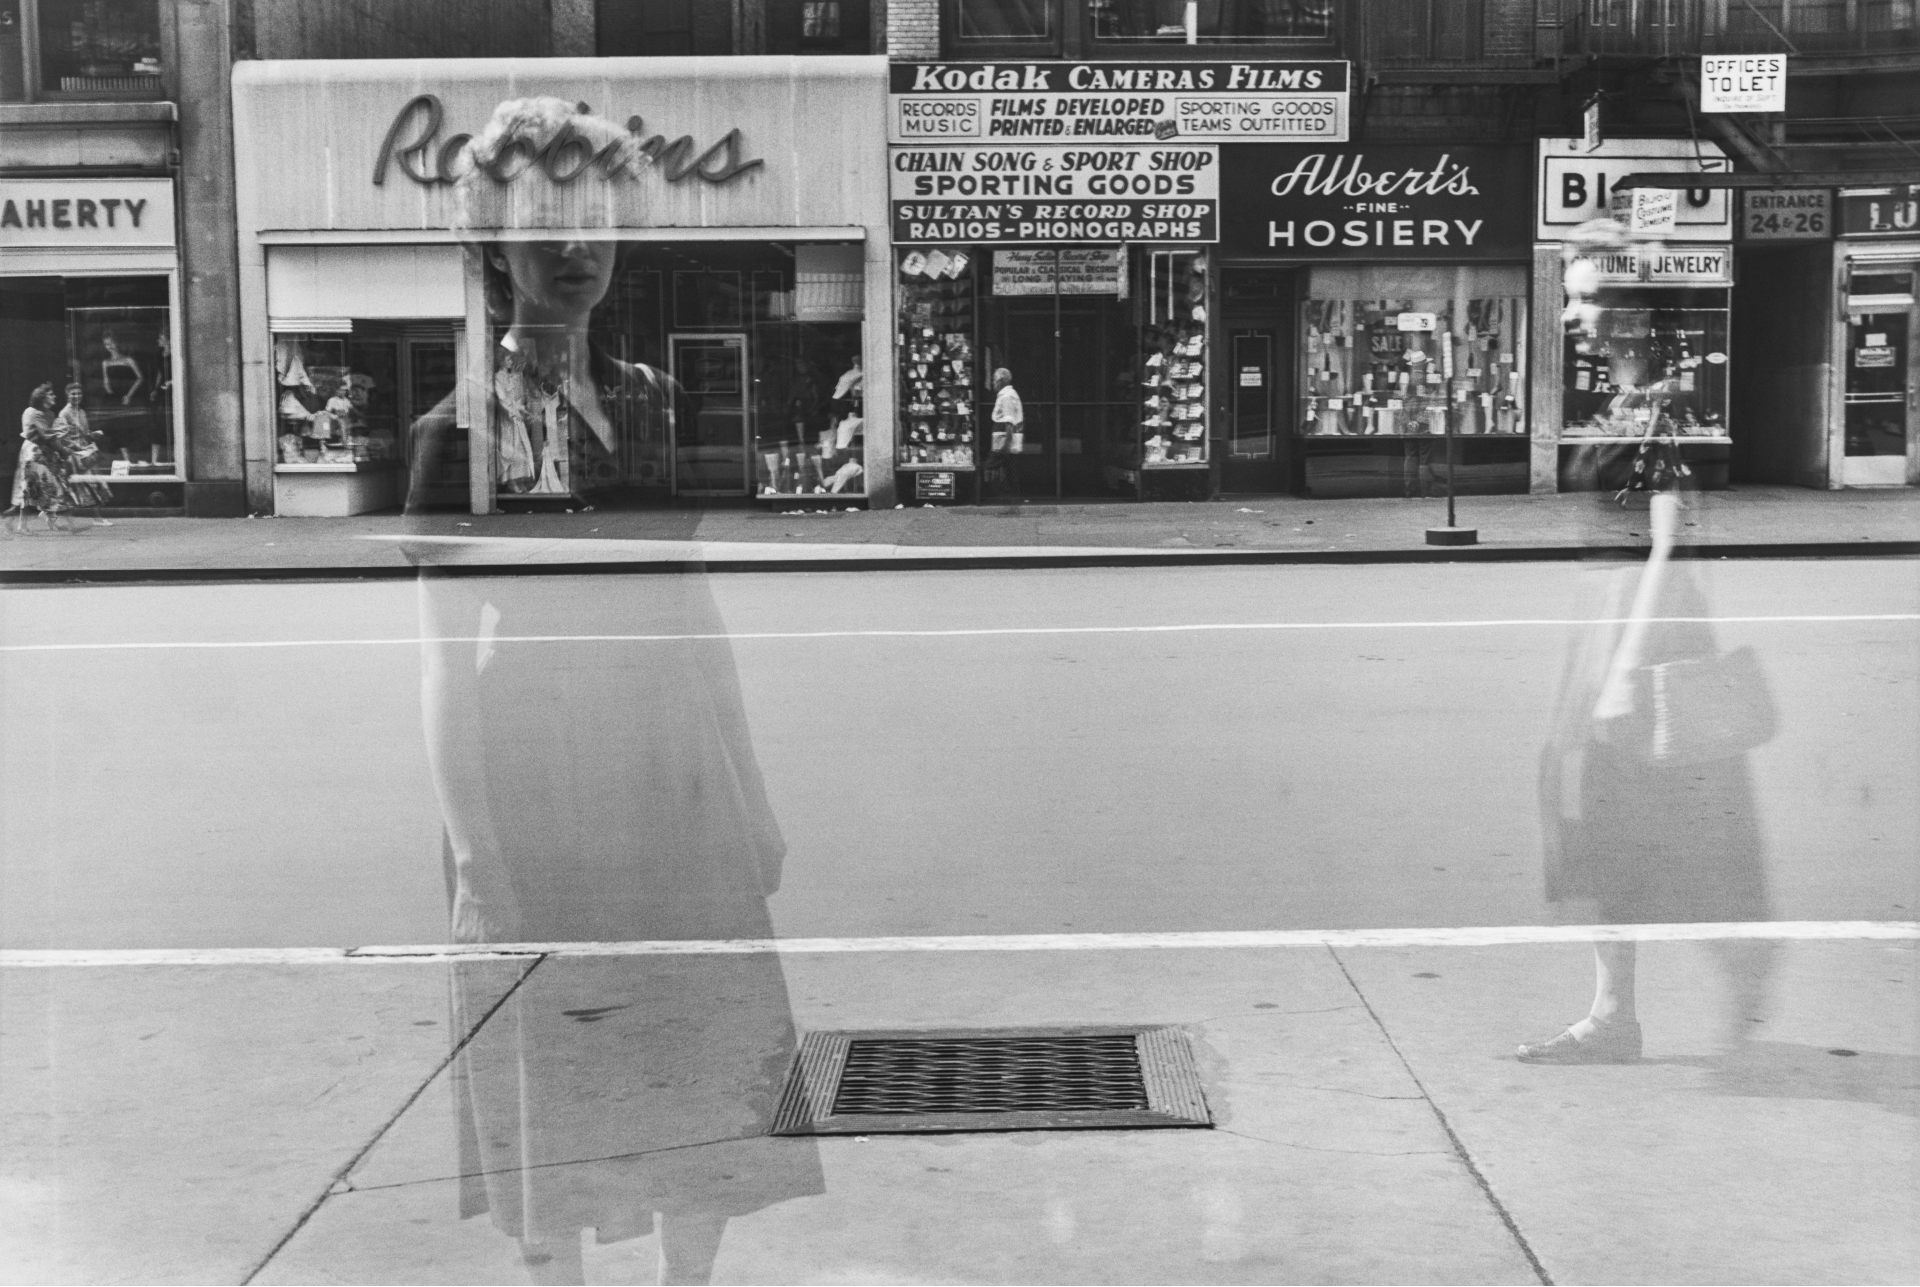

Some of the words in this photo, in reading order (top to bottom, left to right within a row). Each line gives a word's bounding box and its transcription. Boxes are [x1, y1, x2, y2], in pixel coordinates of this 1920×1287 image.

[1705, 60, 1779, 73] OFFICES
[912, 65, 1051, 91] Kodak
[1068, 65, 1215, 90] CAMERAS
[1226, 64, 1323, 90] FILMS
[1708, 76, 1732, 92] TO
[1740, 75, 1777, 92] LET
[902, 102, 977, 117] RECORDS
[990, 98, 1047, 116] FILMS
[1055, 98, 1165, 116] DEVELOPED
[1180, 101, 1261, 116] SPORTING
[1272, 101, 1334, 115] GOODS
[905, 119, 972, 133] MUSIC
[988, 118, 1064, 136] PRINTED
[1073, 118, 1155, 136] ENLARGED
[1183, 118, 1232, 132] TEAMS
[1239, 118, 1326, 132] OUTFITTED
[895, 152, 965, 172] CHAIN
[972, 152, 1037, 171] SONG
[1042, 157, 1054, 172] &
[1060, 151, 1141, 171] SPORT
[1149, 151, 1213, 171] SHOP
[1271, 153, 1480, 196] Albert's
[914, 174, 1073, 196] SPORTING
[1088, 174, 1195, 195] GOODS
[1562, 172, 1711, 209] BIU
[1356, 202, 1399, 213] FINE
[1751, 195, 1825, 208] ENTRANCE
[1, 199, 147, 229] AHERTY
[899, 204, 1024, 220] SULTAN'S
[1033, 204, 1132, 220] RECORD
[1142, 204, 1211, 219] SHOP
[1751, 213, 1780, 233] 24
[1782, 217, 1793, 229] &
[1795, 212, 1825, 232] 26
[1268, 219, 1484, 247] HOSIERY
[1653, 256, 1721, 273] JEWELRY
[1012, 275, 1042, 283] LONG
[1371, 335, 1402, 353] SALE
